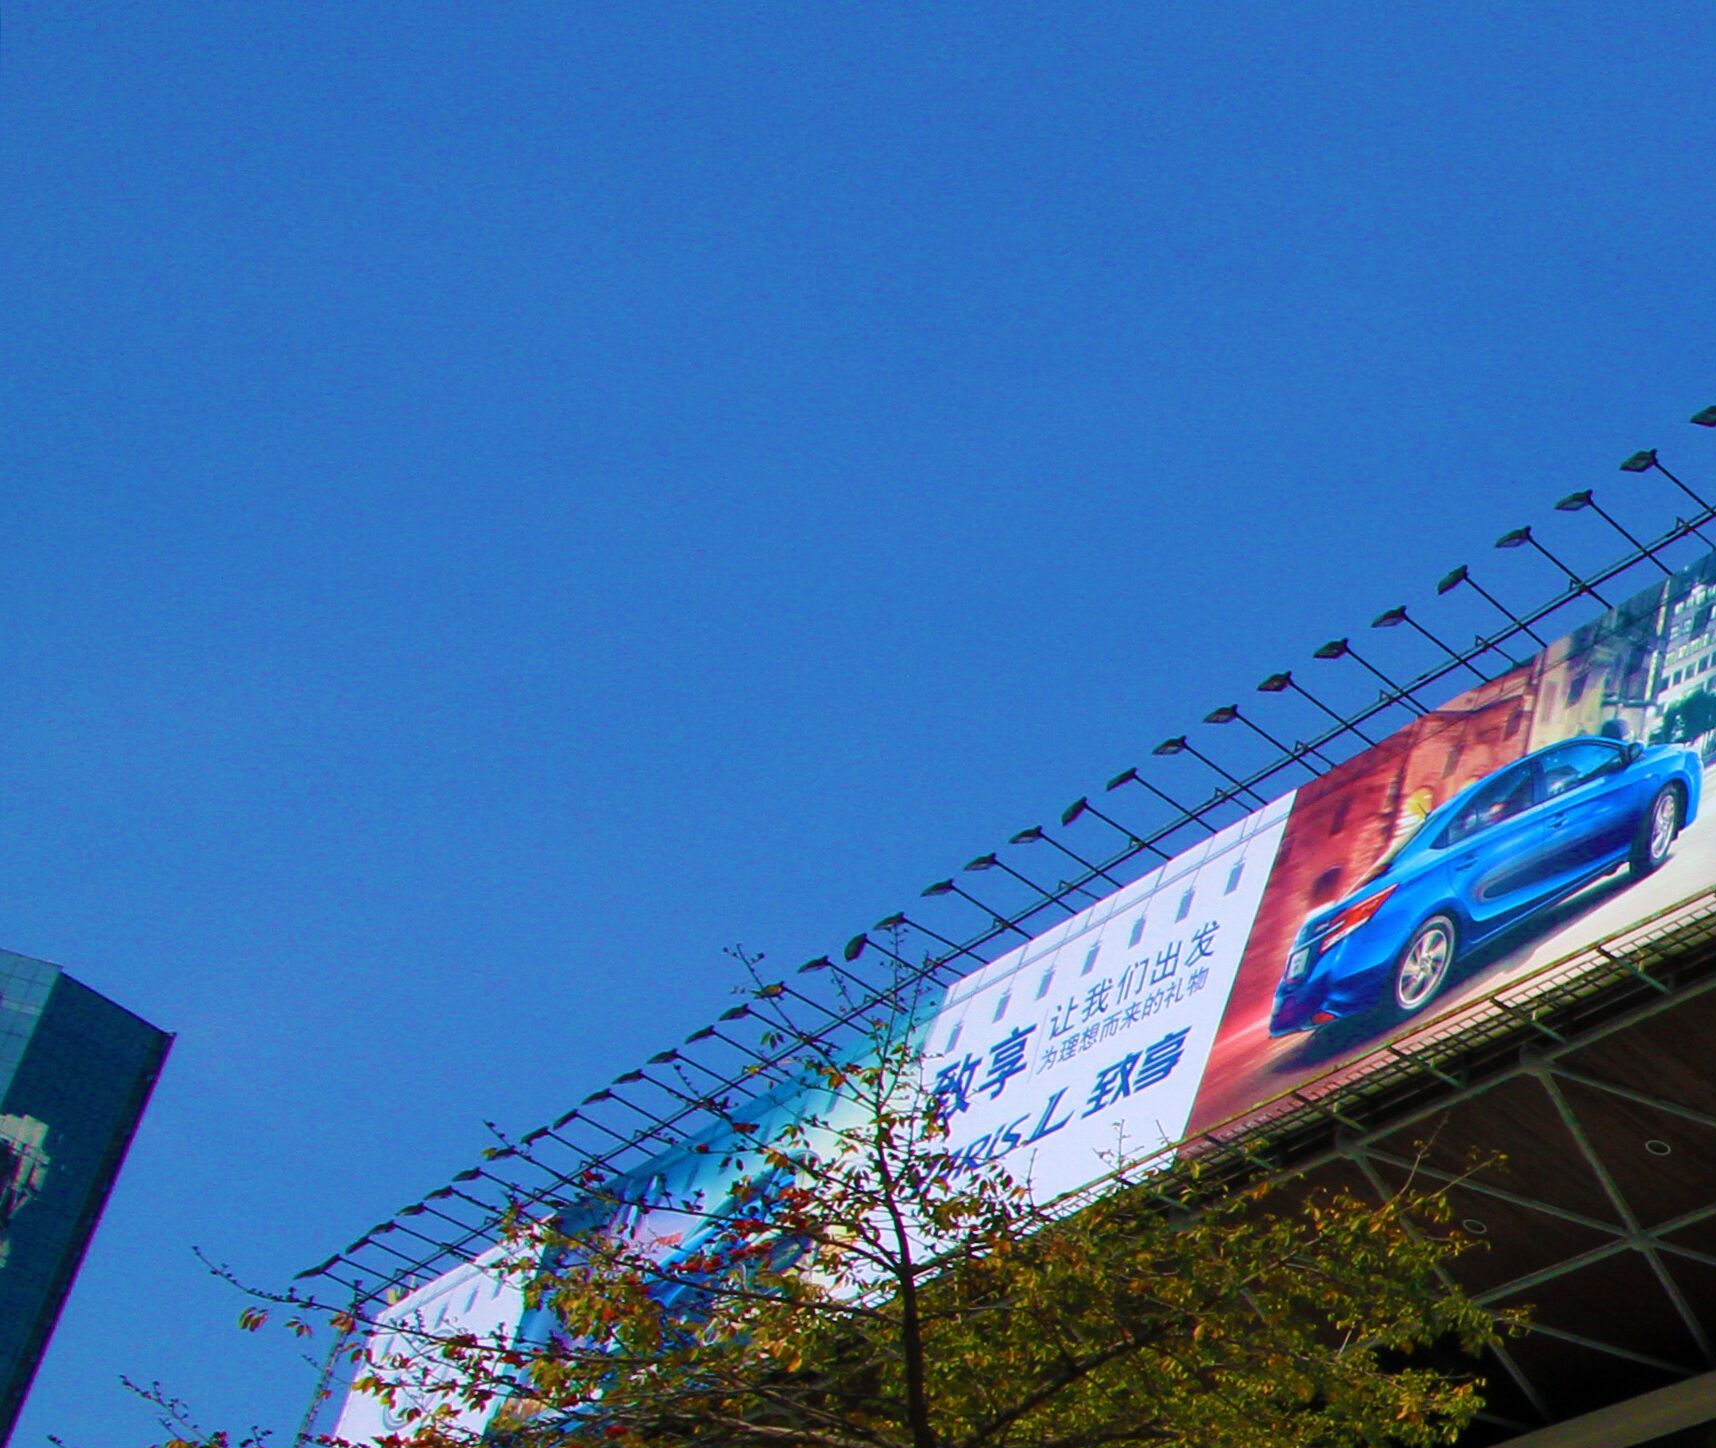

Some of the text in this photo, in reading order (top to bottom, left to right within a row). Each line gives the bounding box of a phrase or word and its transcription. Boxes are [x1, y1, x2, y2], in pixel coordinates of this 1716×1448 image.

[1035, 966, 1210, 1075] 为理想而来的礼物
[1049, 920, 1220, 1041] 让我们出发
